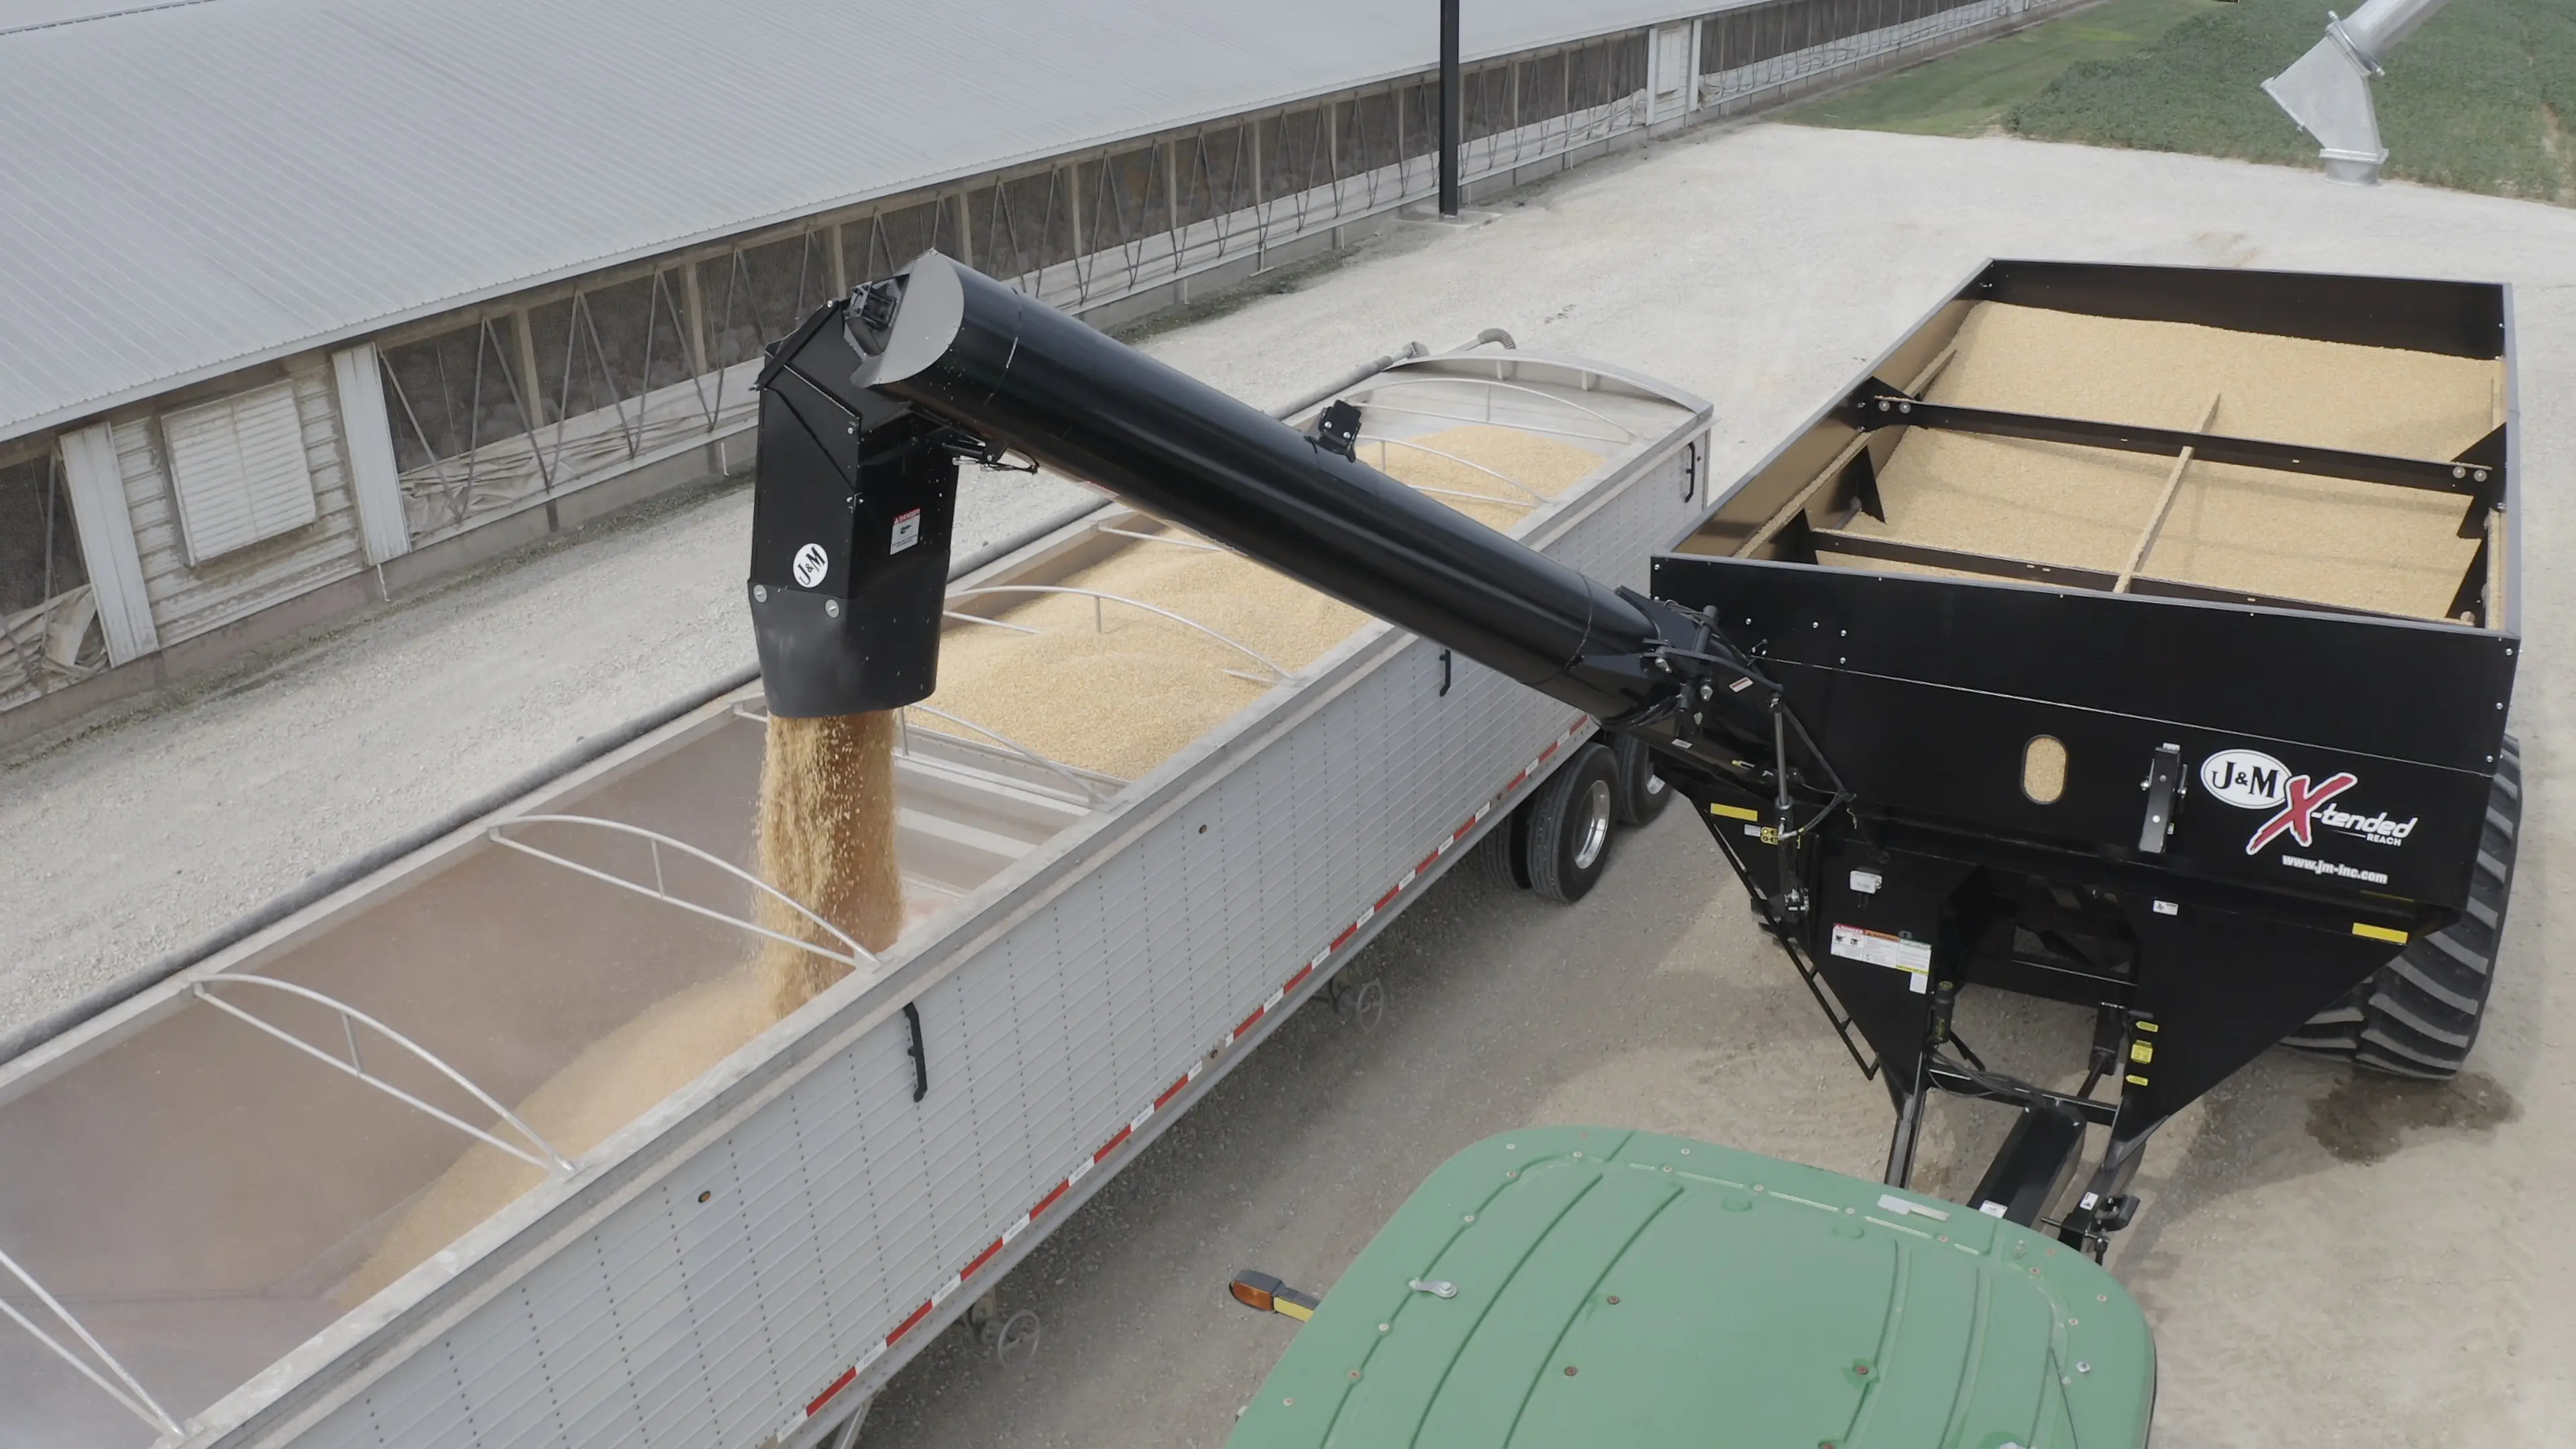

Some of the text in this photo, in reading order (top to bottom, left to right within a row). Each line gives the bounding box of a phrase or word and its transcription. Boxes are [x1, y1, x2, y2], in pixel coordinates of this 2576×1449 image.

[798, 546, 826, 585] J&M
[2212, 761, 2279, 798] J&M
[2367, 834, 2402, 847] REACH
[2282, 855, 2388, 885] www.jm-inc.com
